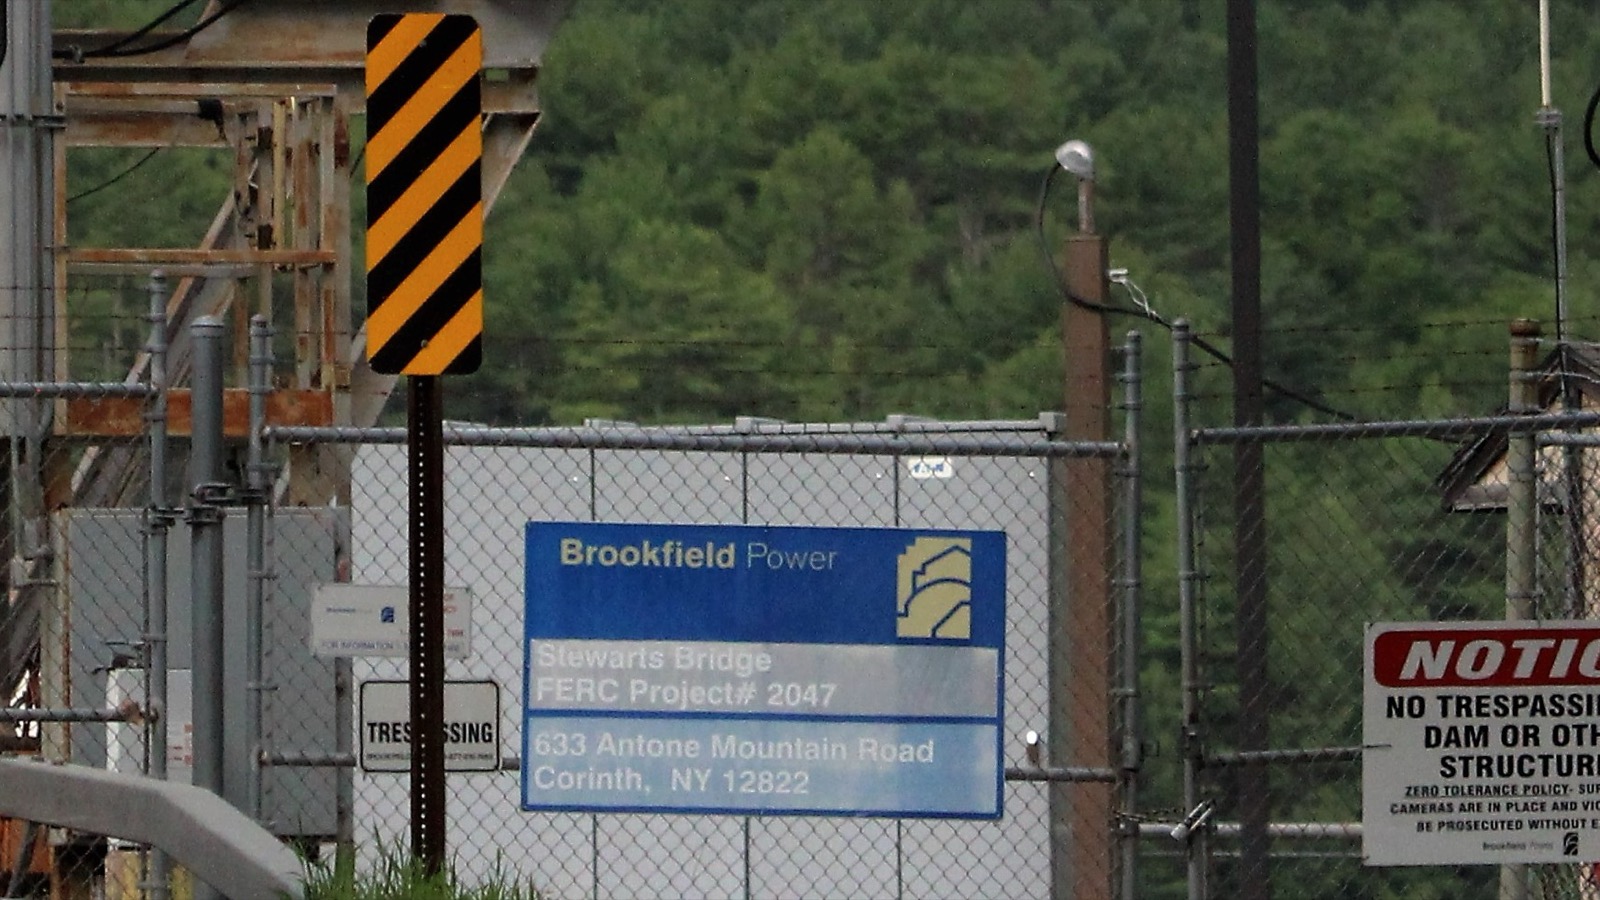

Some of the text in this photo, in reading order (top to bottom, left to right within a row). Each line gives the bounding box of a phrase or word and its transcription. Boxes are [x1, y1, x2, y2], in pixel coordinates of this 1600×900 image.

[560, 537, 836, 571] Brookfield Power
[537, 643, 772, 677] Stewarts Bridge
[536, 678, 836, 709] FERC Project# 2047
[1386, 693, 1600, 719] NO TRESPASSI
[367, 722, 493, 743] TRESSSING
[1424, 725, 1490, 749] DAM
[1501, 724, 1540, 747] OR
[533, 733, 935, 764] 633 Antone Mountain Road
[1439, 754, 1600, 778] STRUCTUR
[533, 765, 810, 795] Corinth, NY 12822
[1405, 785, 1439, 797] ZERO
[1444, 784, 1518, 797] TOLERANCE
[1390, 802, 1454, 815] CAMERAS
[1458, 801, 1483, 813] ARE
[1488, 801, 1501, 812] IN
[1506, 801, 1547, 813] PLACE
[1551, 801, 1578, 812] AND
[1416, 821, 1433, 832] BE
[1437, 820, 1523, 832] PROSECUTED
[1528, 819, 1587, 831] WITHOUT
